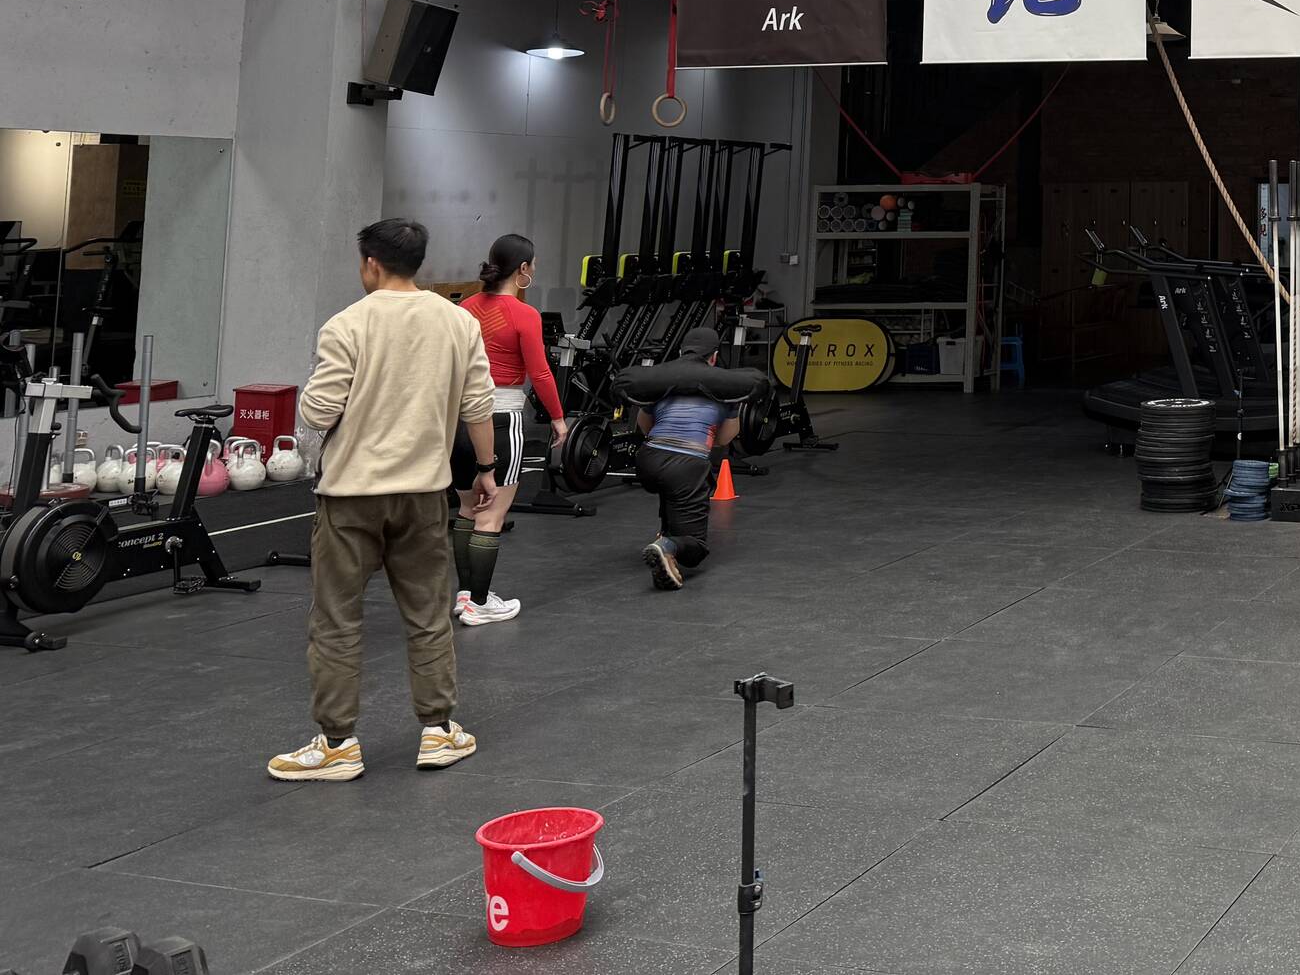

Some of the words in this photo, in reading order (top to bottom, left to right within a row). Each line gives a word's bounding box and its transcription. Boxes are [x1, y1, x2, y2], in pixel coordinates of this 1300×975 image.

[761, 6, 805, 33] Ark
[239, 408, 270, 420] 灭火器柜
